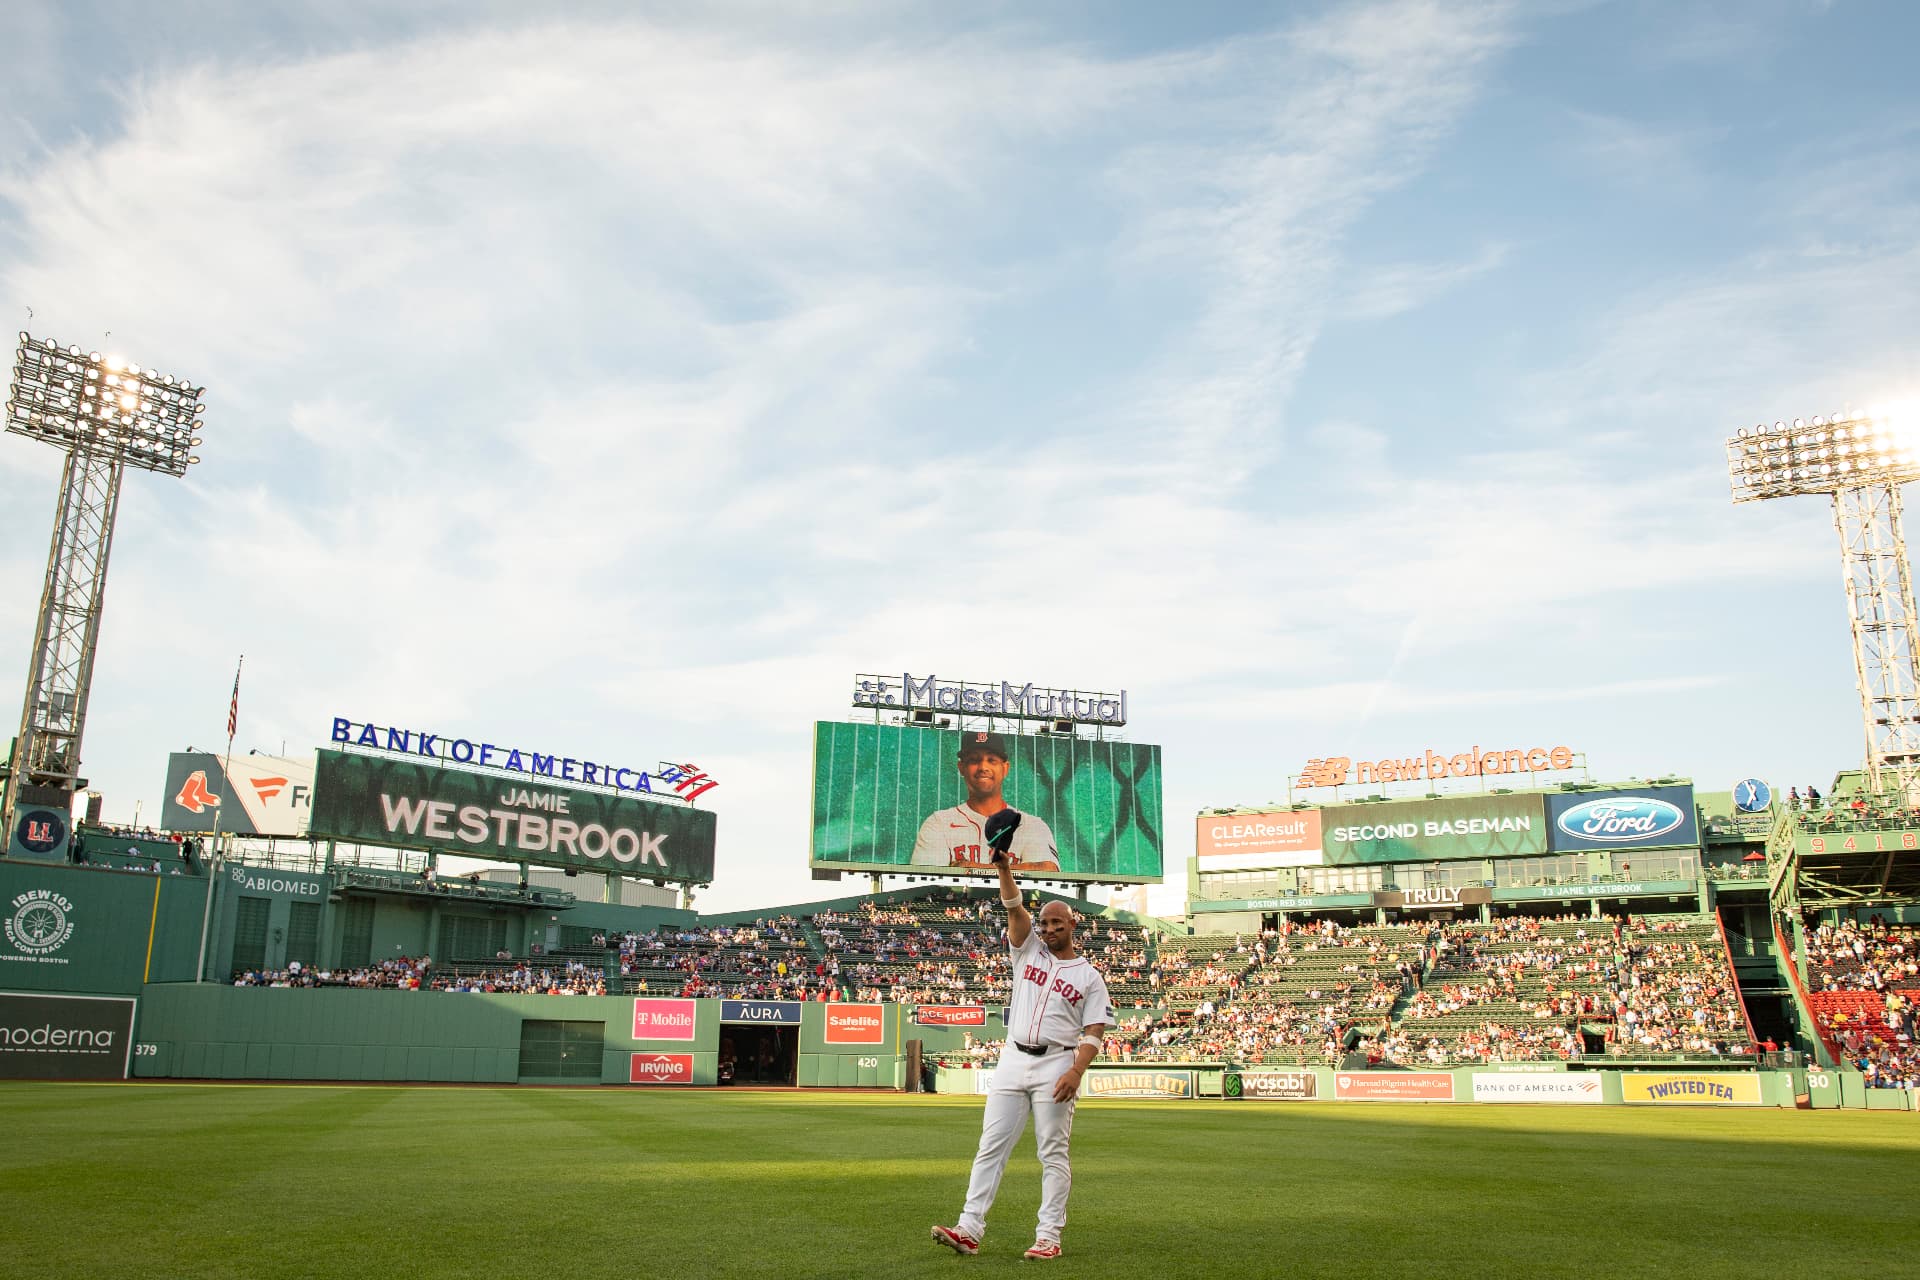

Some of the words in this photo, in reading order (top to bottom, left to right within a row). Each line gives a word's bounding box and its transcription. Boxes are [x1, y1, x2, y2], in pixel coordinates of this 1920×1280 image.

[903, 672, 1127, 722] MassMutual
[331, 716, 440, 758] BANK
[451, 738, 495, 766] OF
[505, 748, 653, 794] AMERICA
[1357, 757, 1421, 784] new
[1425, 745, 1573, 779] balance
[500, 788, 570, 815] JAMIE
[1583, 803, 1657, 834] Ford
[381, 793, 669, 868] WESTBROOK
[1211, 821, 1306, 840] CLEAResult
[1333, 822, 1418, 842] SECOND
[1424, 816, 1530, 837] BASEMAN
[1811, 838, 1824, 853] 9
[1844, 836, 1856, 850] 4
[1876, 835, 1884, 850] 1
[1902, 834, 1916, 848] 8
[245, 876, 320, 896] ABIOMED
[1401, 887, 1463, 903] TRULY
[1542, 888, 1554, 896] 73
[1557, 886, 1585, 896] JAMIE
[1588, 884, 1642, 894] WESTBROOK
[12, 890, 52, 908] IBEW
[52, 893, 73, 912] 103
[1247, 900, 1278, 909] BOSTON
[1280, 900, 1296, 908] RED
[14, 922, 74, 954] CONTRACTORS
[1024, 964, 1048, 986] RED
[1052, 978, 1083, 1007] SOX
[651, 1012, 691, 1026] Mobile
[829, 1016, 880, 1026] Safelite
[921, 1008, 944, 1018] ACE
[945, 1010, 983, 1022] TICKET
[135, 1044, 157, 1056] 379
[640, 1062, 683, 1074] IRVING
[858, 1057, 878, 1068] 420
[1090, 1074, 1152, 1094] GRANITE
[1155, 1074, 1187, 1096] CITY
[1242, 1074, 1304, 1090] wasabi
[1382, 1080, 1408, 1089] Pilgrim
[1647, 1080, 1705, 1100] TWISTED
[1708, 1083, 1733, 1100] TEA
